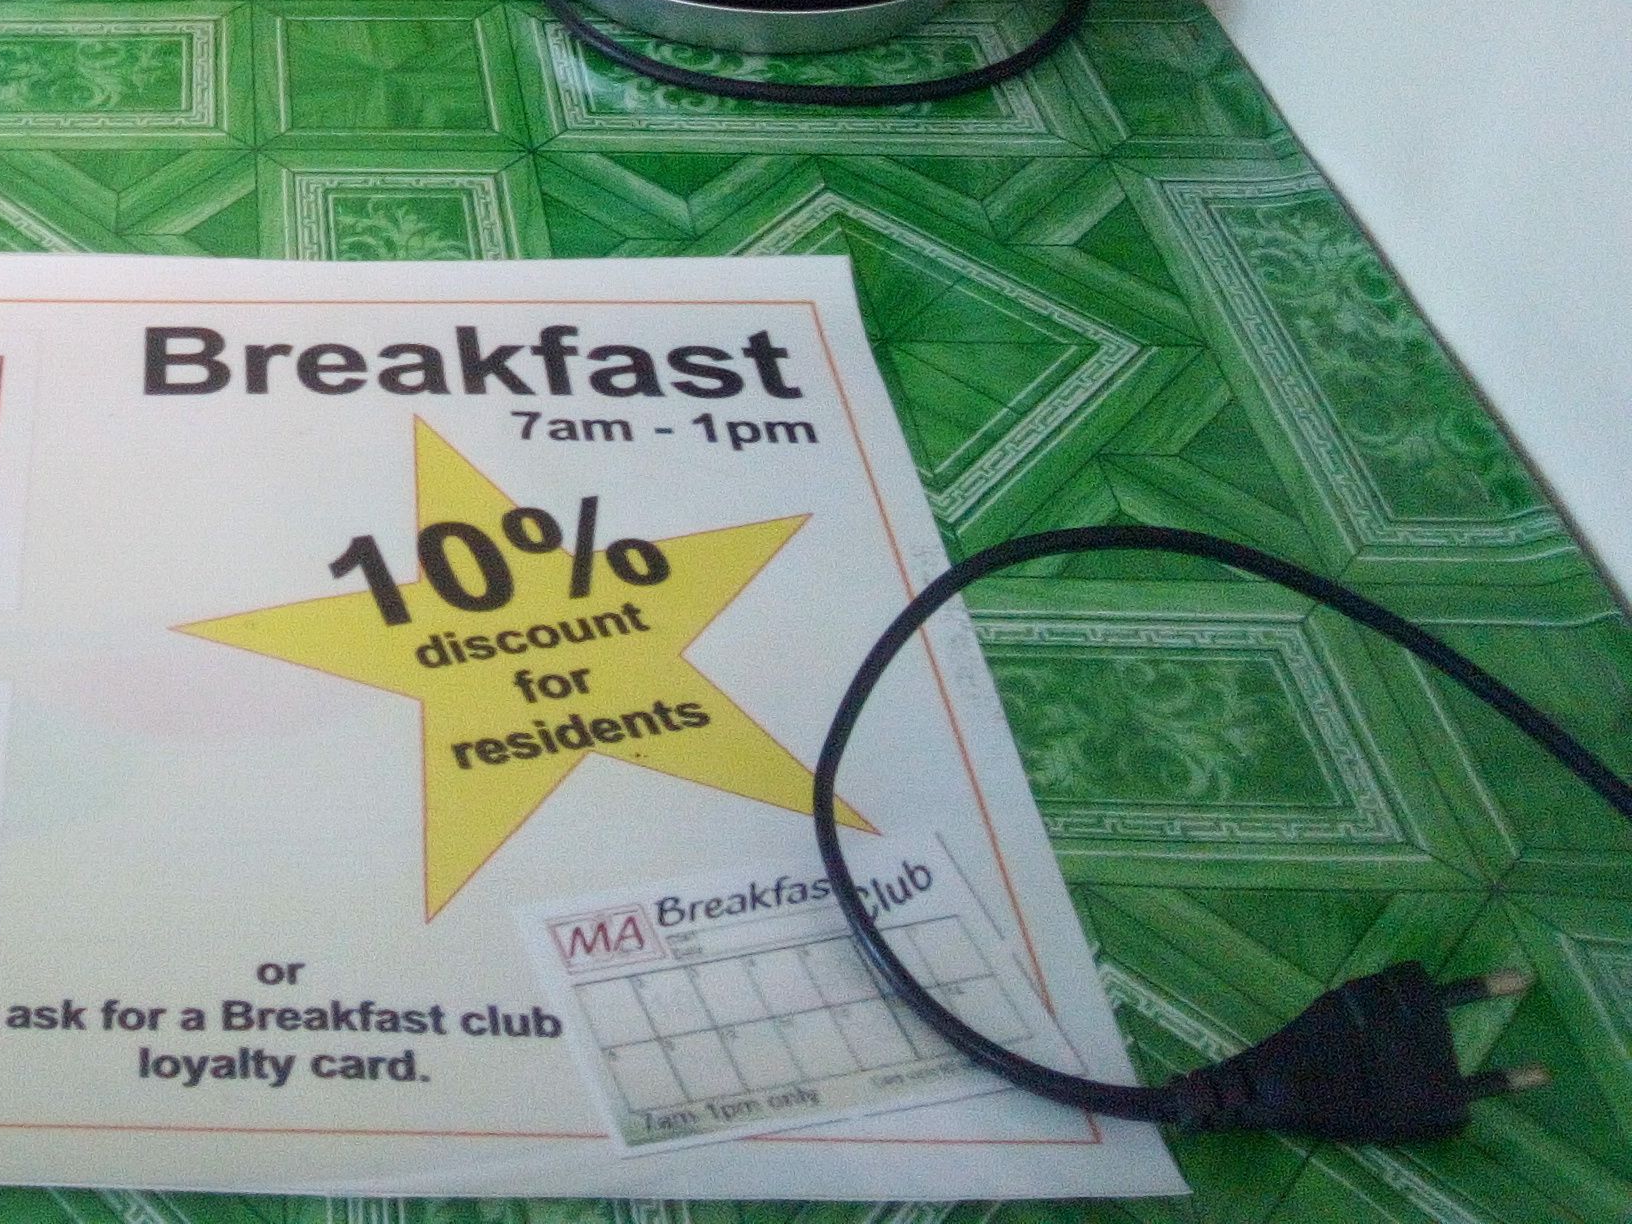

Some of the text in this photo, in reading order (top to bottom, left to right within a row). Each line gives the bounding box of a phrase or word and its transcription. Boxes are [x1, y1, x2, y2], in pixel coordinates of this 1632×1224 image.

[143, 325, 803, 400] Breakfast
[510, 410, 820, 451] 7am - 1pm
[328, 495, 672, 627] 10%
[415, 601, 651, 670] discount
[514, 665, 593, 705] for
[451, 695, 713, 772] residents
[568, 915, 644, 959] MA
[653, 873, 833, 929] Breakfas
[255, 961, 307, 987] or
[5, 998, 565, 1039] ask for a Breakfast club
[137, 1046, 433, 1088] loyalty card.
